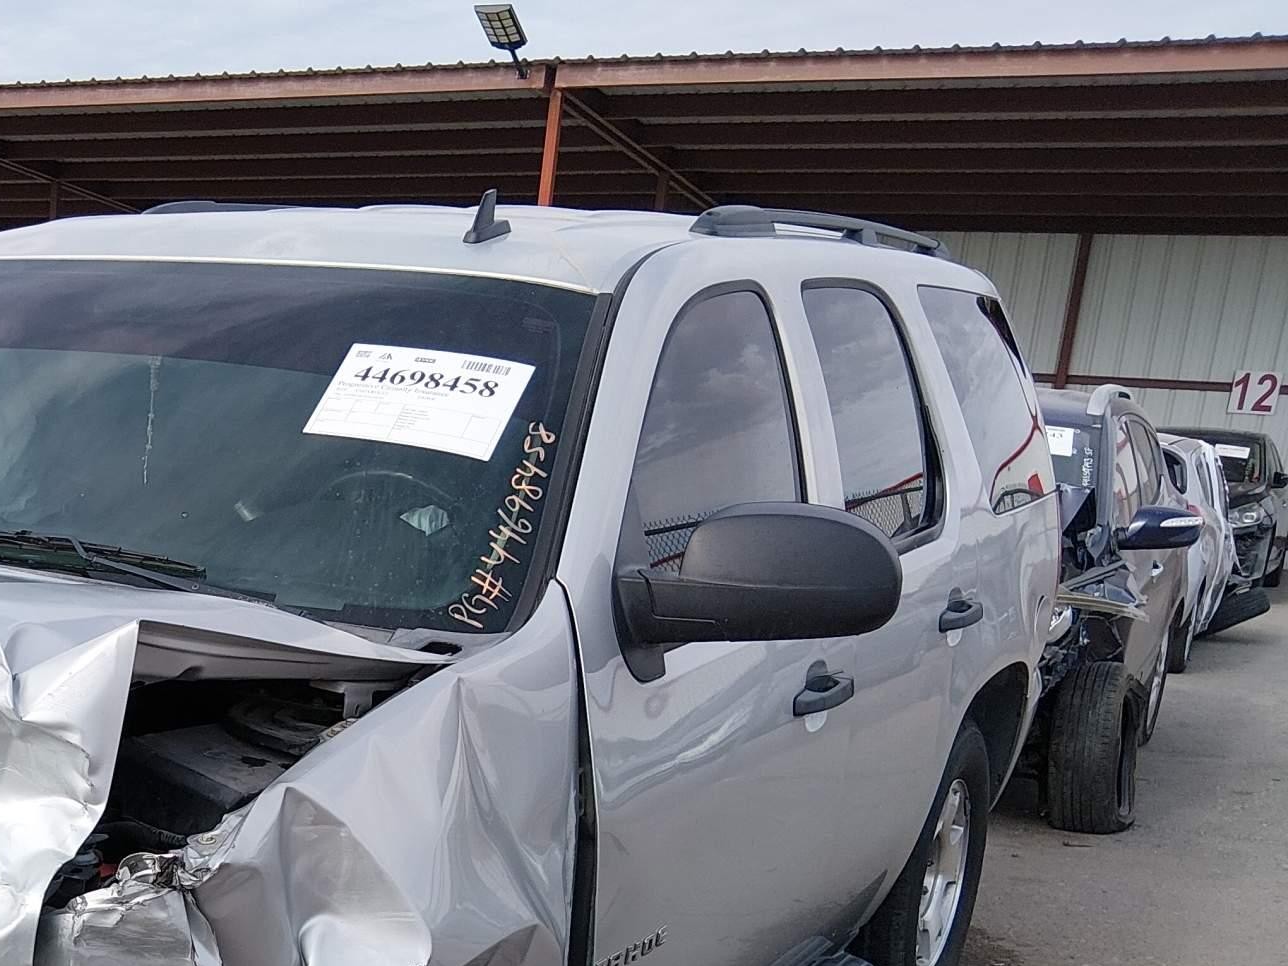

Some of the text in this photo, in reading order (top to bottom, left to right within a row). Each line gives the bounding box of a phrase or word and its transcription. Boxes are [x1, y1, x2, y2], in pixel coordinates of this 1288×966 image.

[354, 365, 500, 398] 44698458
[1233, 371, 1279, 413] 12
[448, 420, 556, 629] PG#44698458
